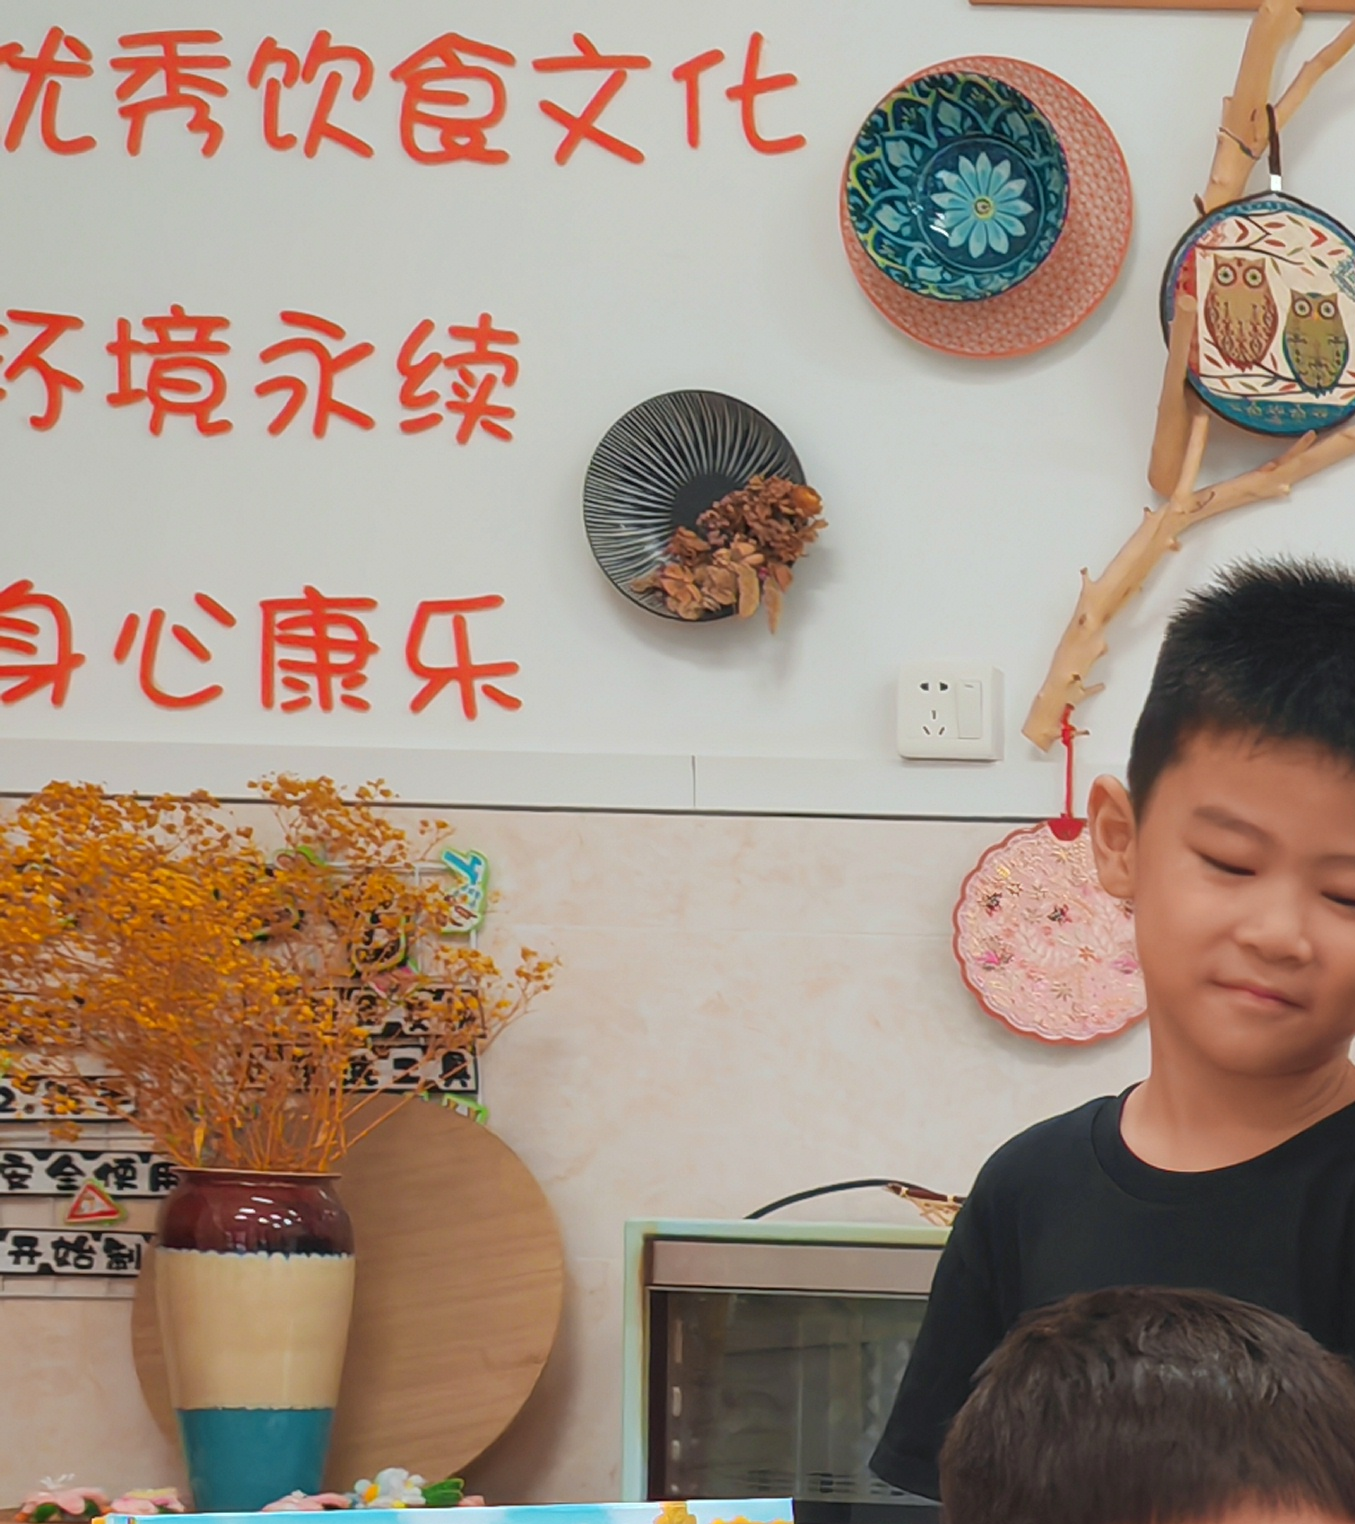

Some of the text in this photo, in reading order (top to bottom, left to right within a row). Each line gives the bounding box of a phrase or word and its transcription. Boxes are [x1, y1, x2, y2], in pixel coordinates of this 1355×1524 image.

[0, 25, 806, 168] 优秀饮食文化
[0, 304, 521, 446] 环境永续
[0, 578, 524, 720] 身心康乐
[0, 1153, 179, 1192] 安全使用
